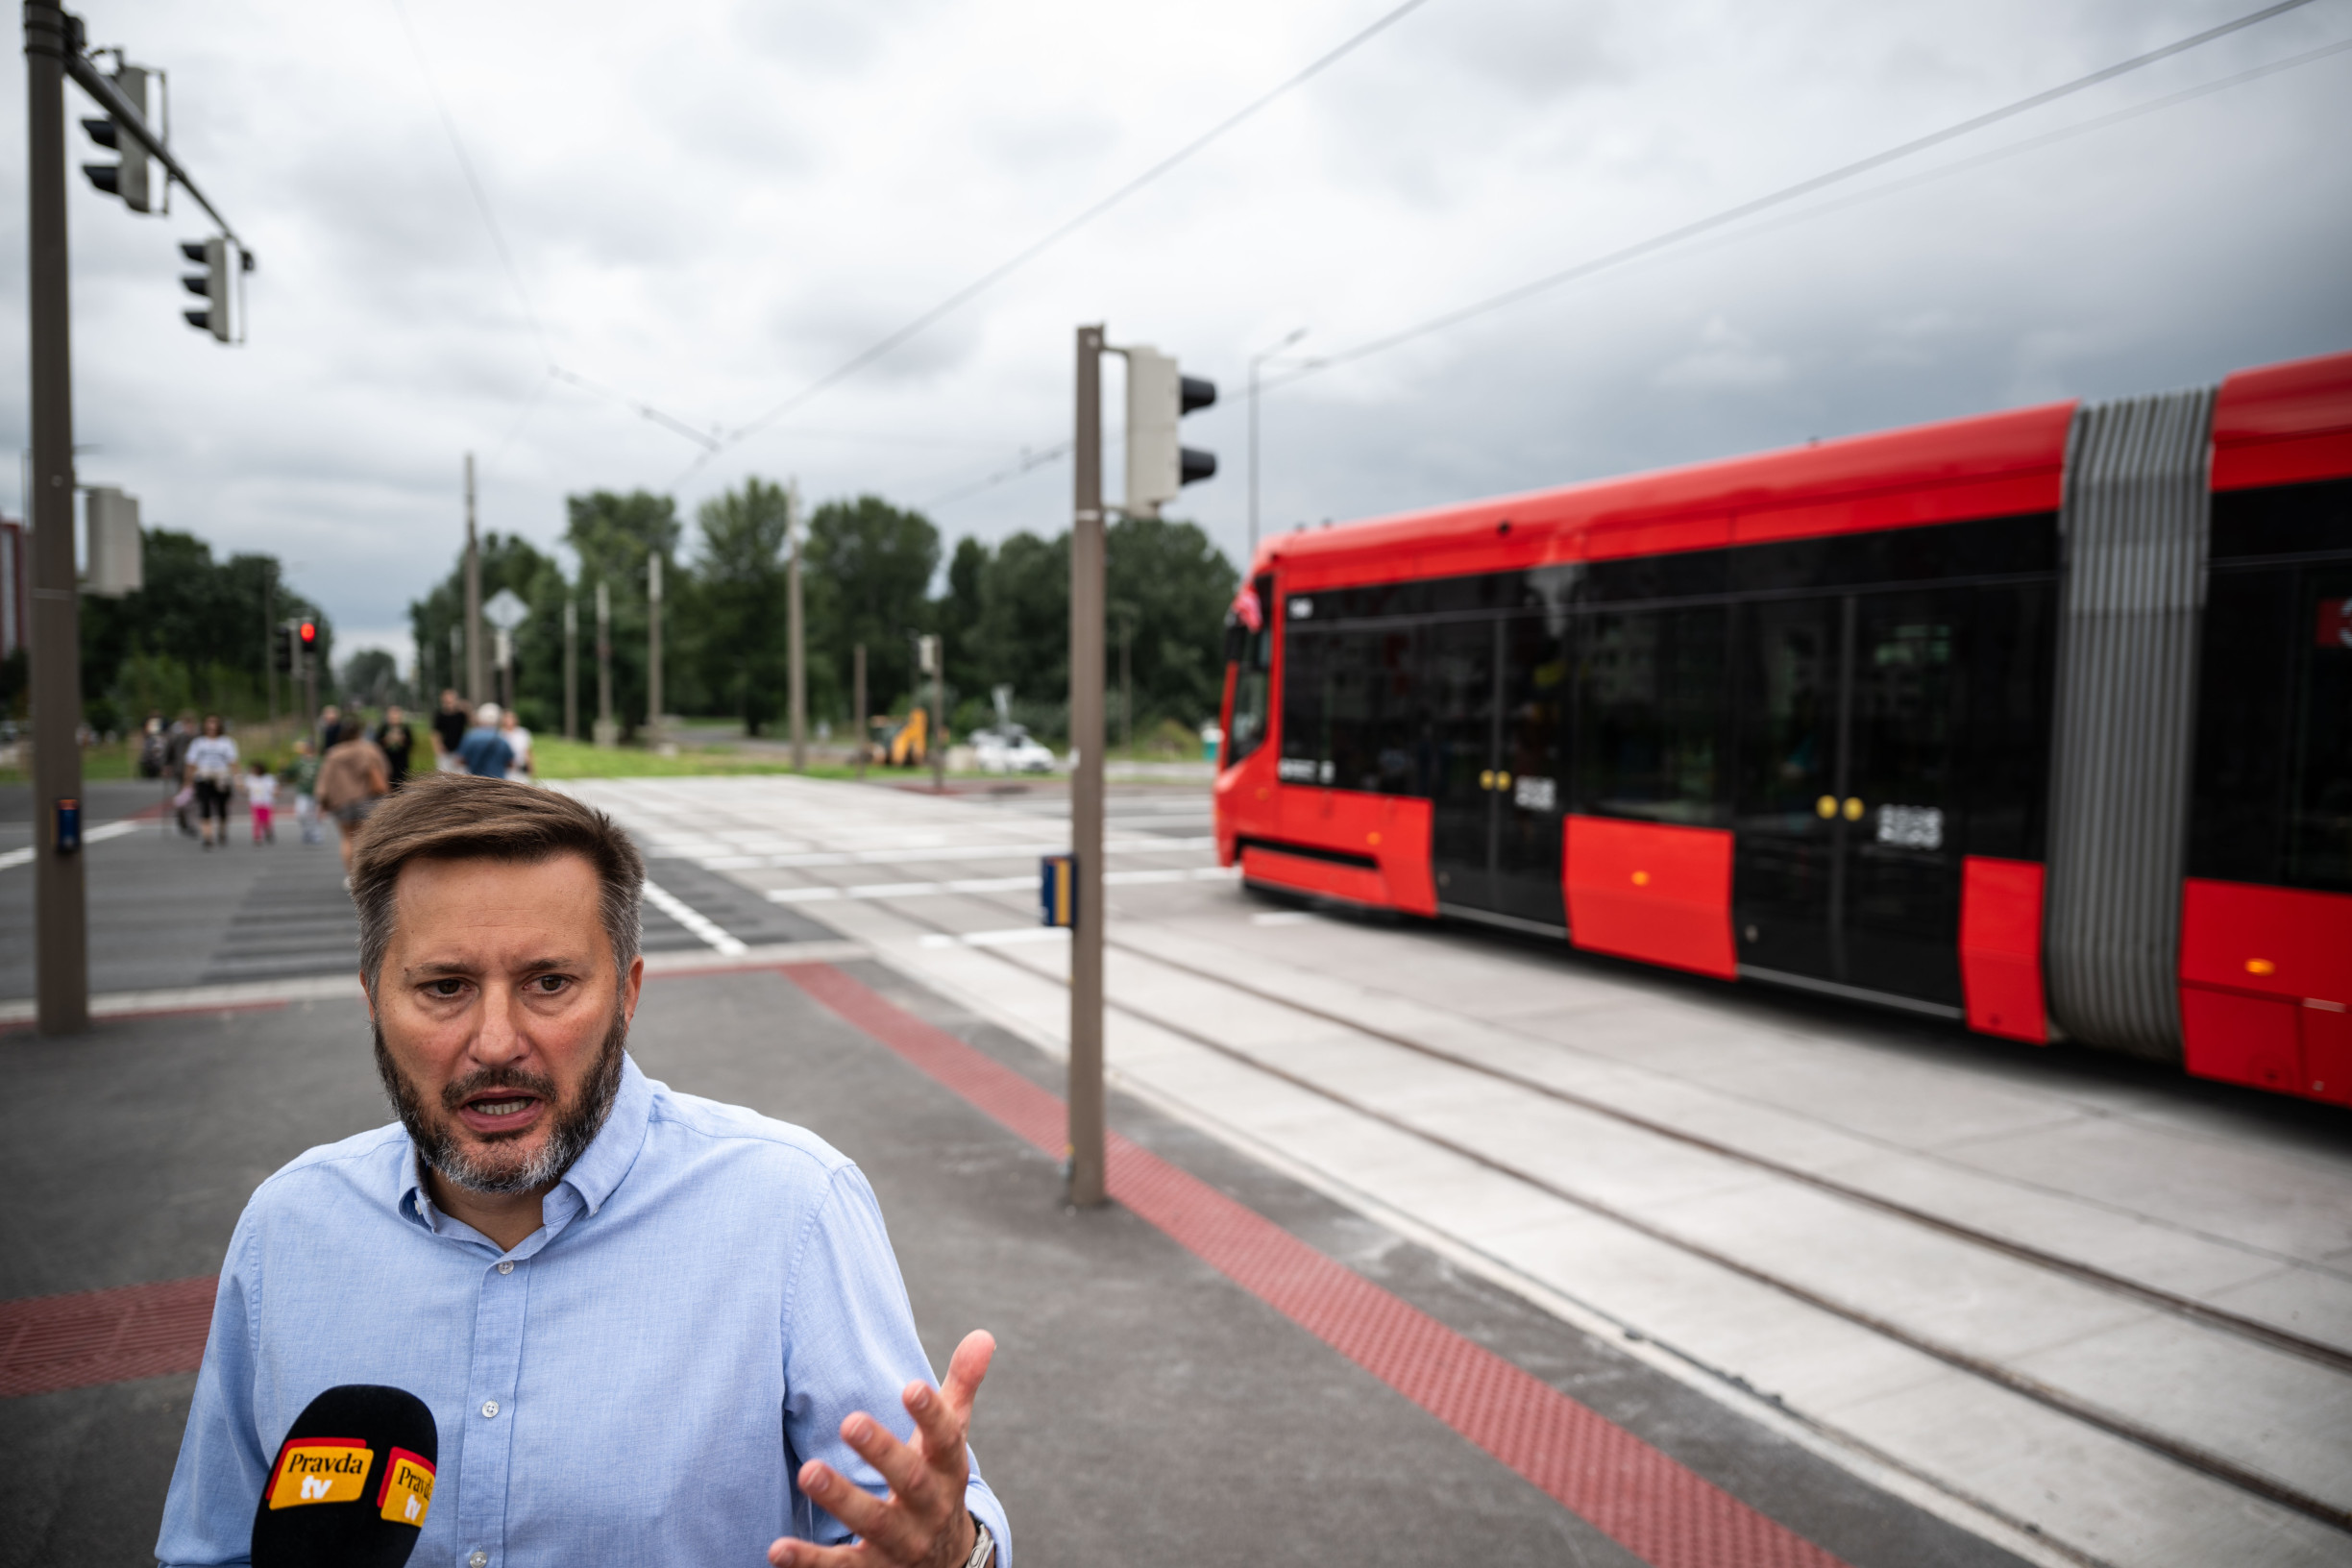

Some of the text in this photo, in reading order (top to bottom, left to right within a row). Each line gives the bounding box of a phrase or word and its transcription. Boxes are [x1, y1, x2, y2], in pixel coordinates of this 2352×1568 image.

[287, 1453, 363, 1474] Pravda
[300, 1475, 332, 1499] tv
[398, 1466, 434, 1502] Pravd
[404, 1494, 422, 1521] tv
